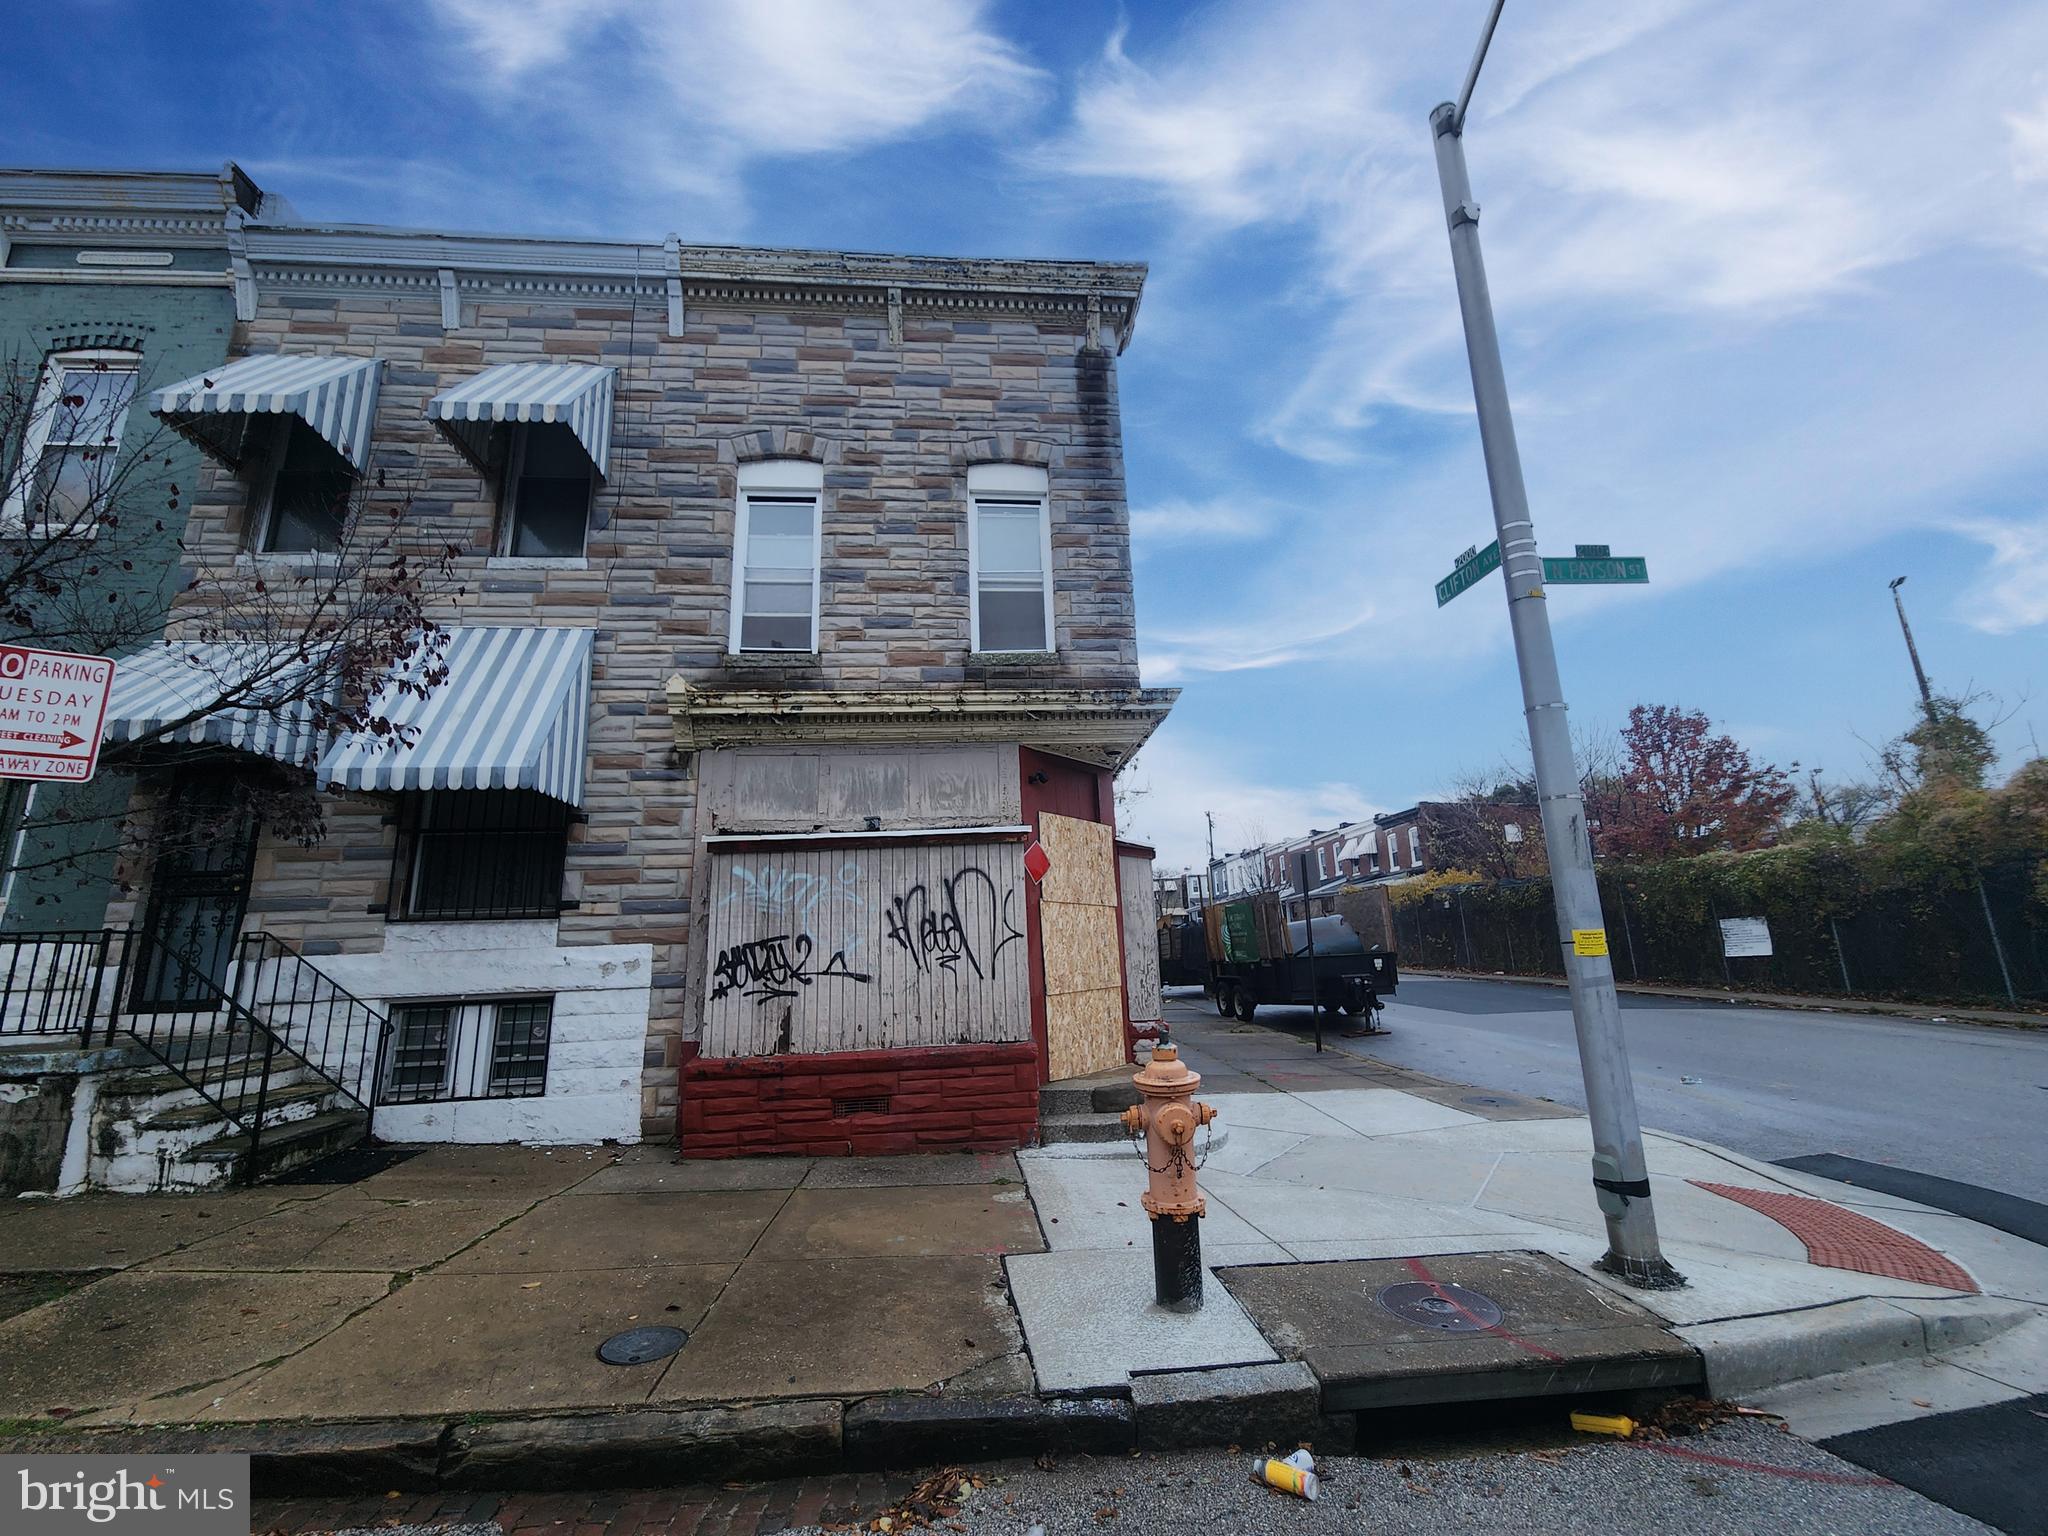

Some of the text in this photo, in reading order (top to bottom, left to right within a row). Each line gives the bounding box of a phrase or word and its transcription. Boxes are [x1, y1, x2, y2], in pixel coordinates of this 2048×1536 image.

[1552, 560, 1641, 578] N PAYSON ST
[1439, 560, 1480, 600] CLIFTON
[0, 653, 105, 683] O PARKING
[0, 685, 93, 708] UESDAY
[28, 710, 46, 723] TO
[23, 732, 71, 744] CLEANING
[46, 760, 84, 774] ZONE
